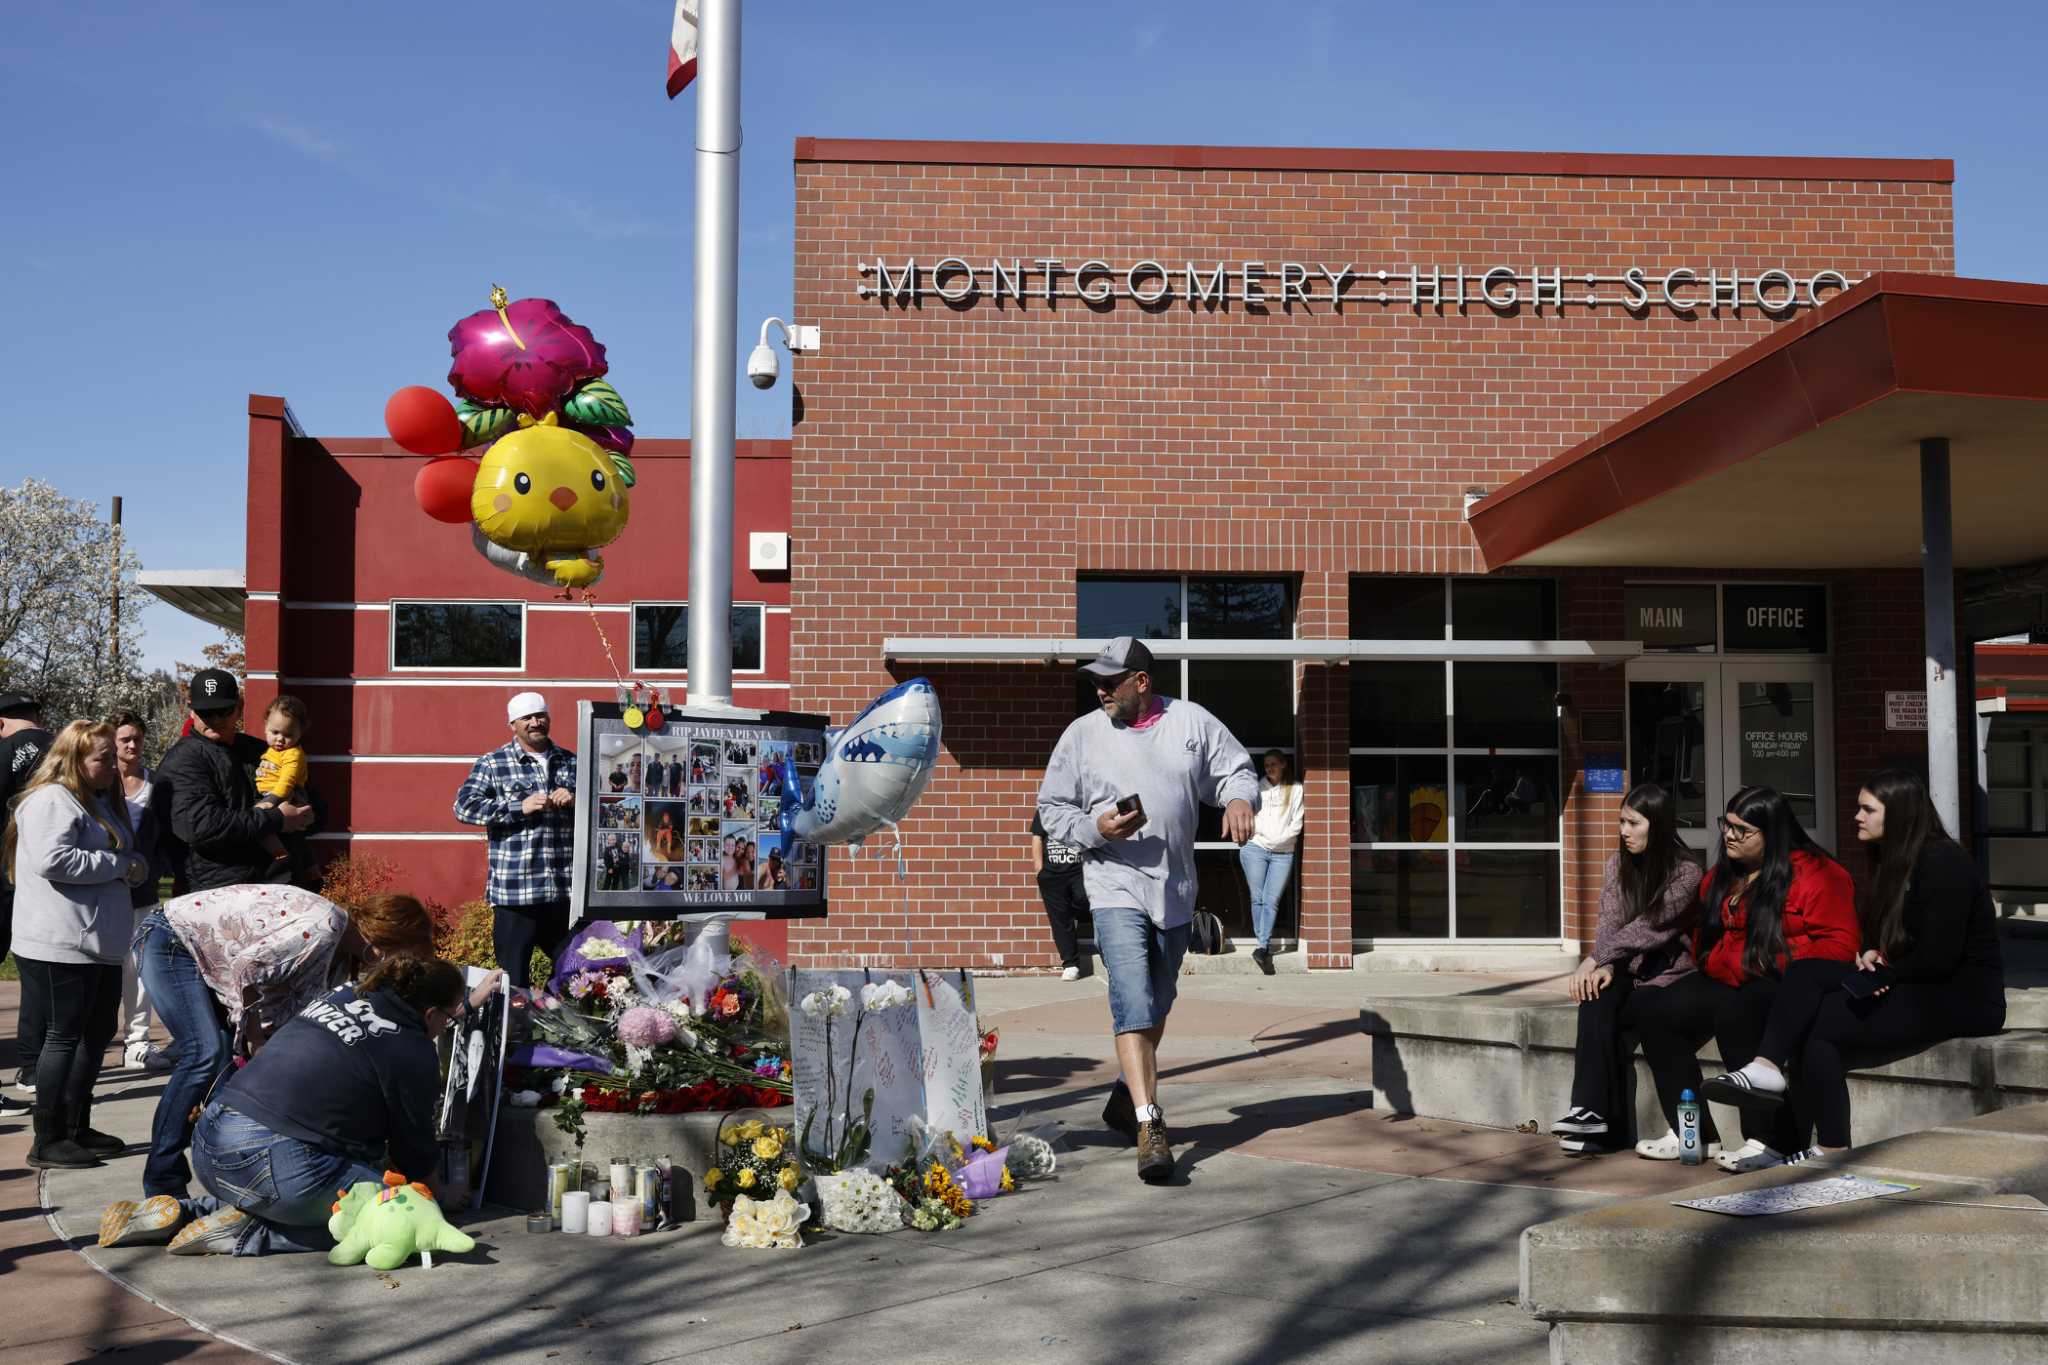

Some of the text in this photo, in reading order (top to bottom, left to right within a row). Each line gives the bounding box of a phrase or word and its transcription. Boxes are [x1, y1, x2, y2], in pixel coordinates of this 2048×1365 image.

[876, 257, 1871, 312] MONTGOMERY HIGH SCHOO
[1640, 606, 1804, 628] MAIN OFFICE
[204, 679, 218, 696] SF
[672, 727, 773, 740] RIP JAYDEN PIENTA
[1745, 731, 1808, 741] OFFICE HOURS
[683, 892, 753, 903] WE LOVE YOU
[299, 999, 363, 1042] ANCER
[1684, 1110, 1696, 1150] core
